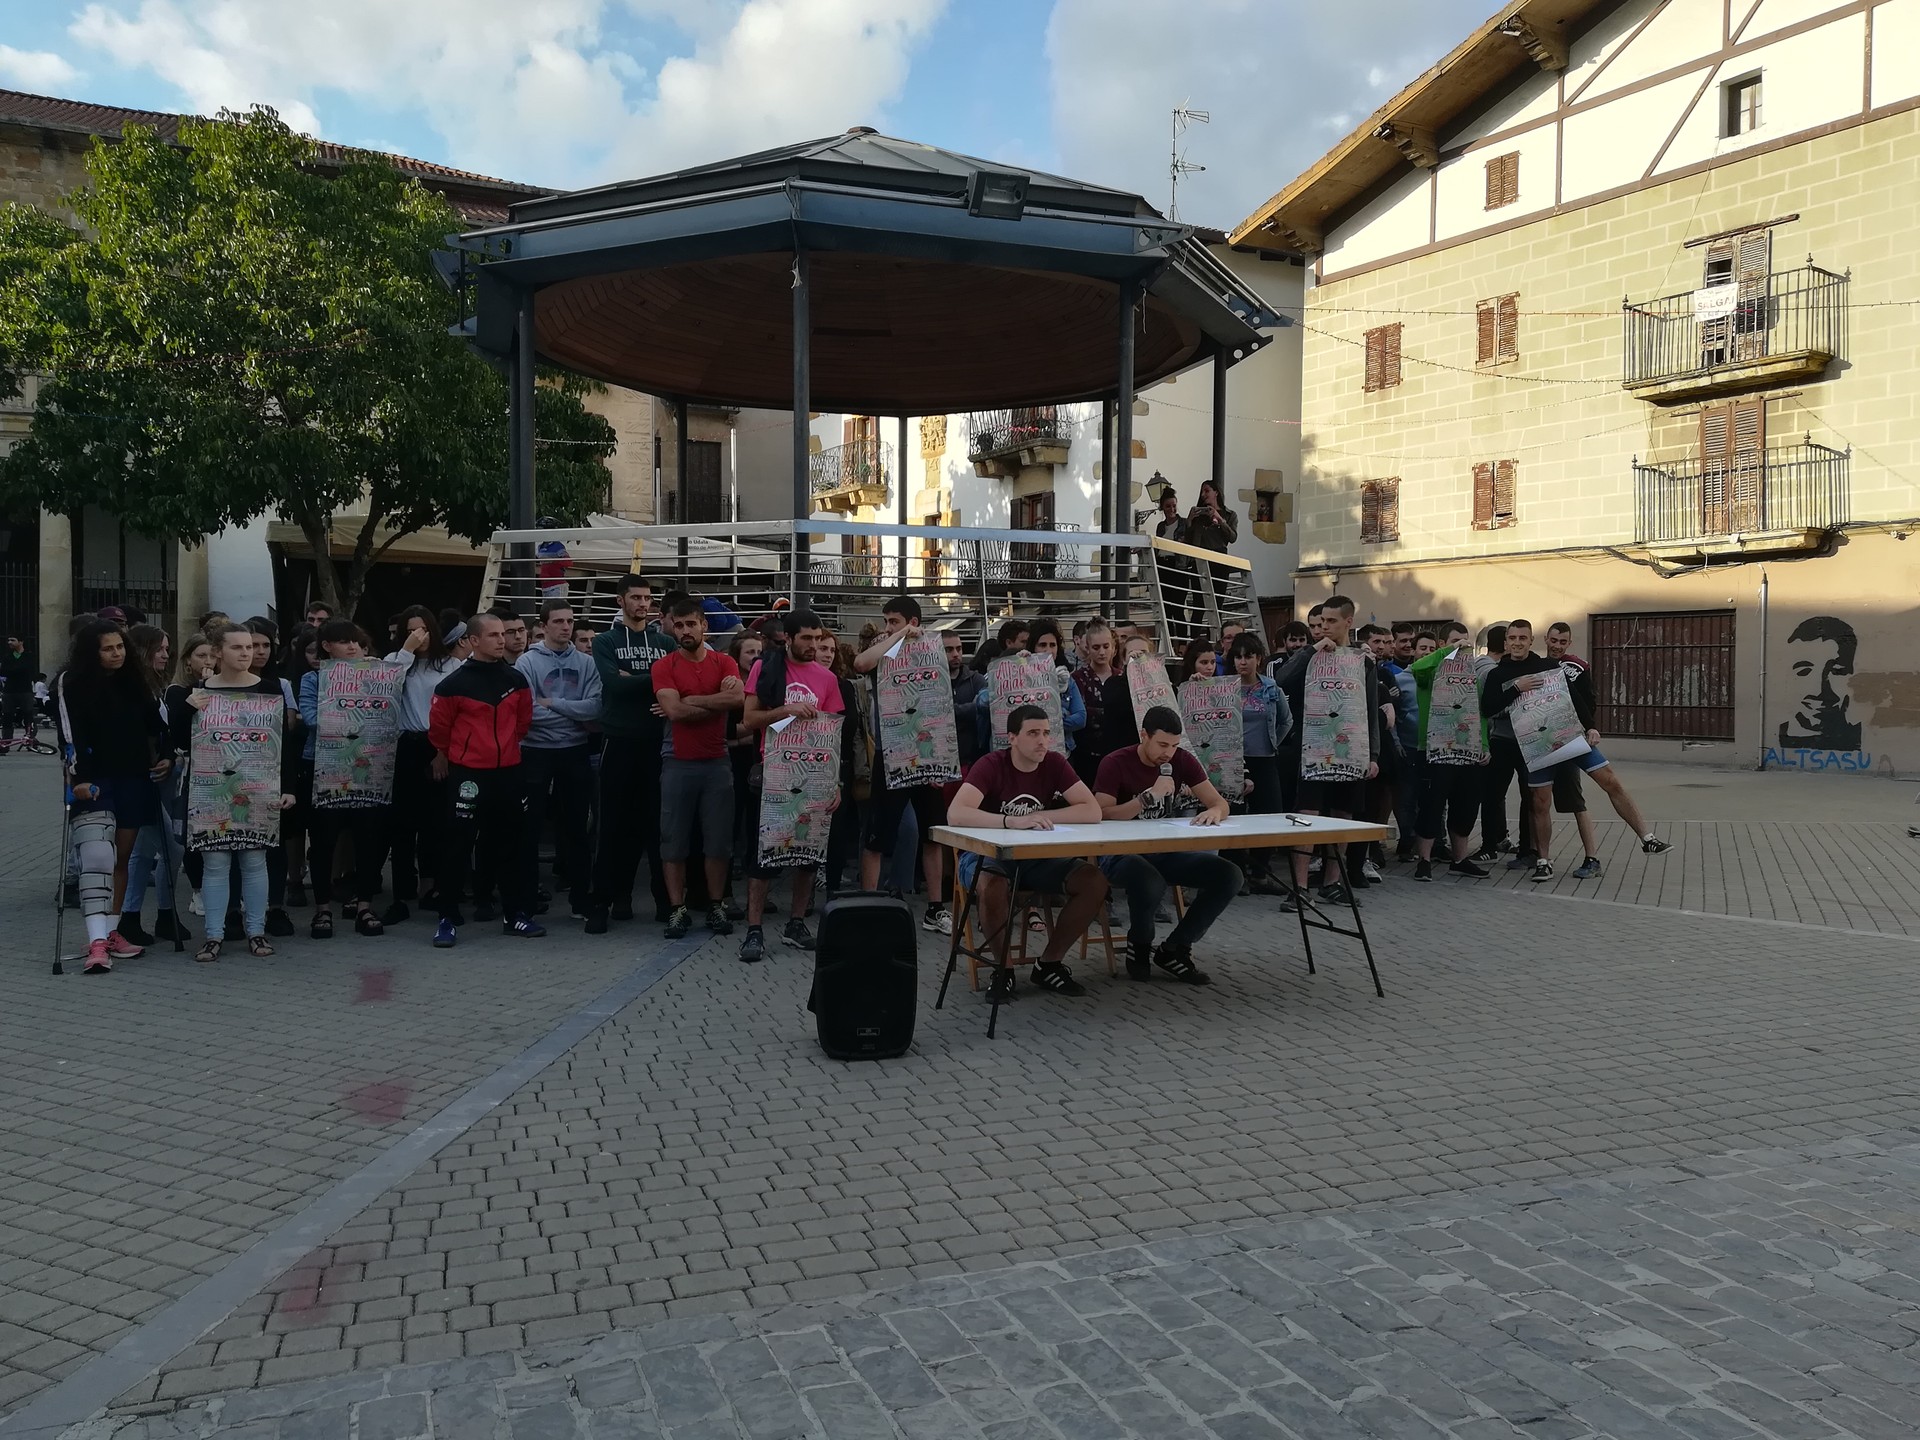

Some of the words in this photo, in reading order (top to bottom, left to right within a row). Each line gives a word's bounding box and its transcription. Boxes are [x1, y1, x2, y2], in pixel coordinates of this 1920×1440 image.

[615, 646, 667, 660] ULL&BEAR
[919, 651, 940, 667] 2019
[631, 660, 650, 670] 1991
[370, 682, 394, 695] 2019
[1215, 696, 1235, 708] 2019
[247, 713, 272, 727] 2019
[814, 734, 834, 747] 2019
[1763, 747, 1871, 771] ALTSASU
